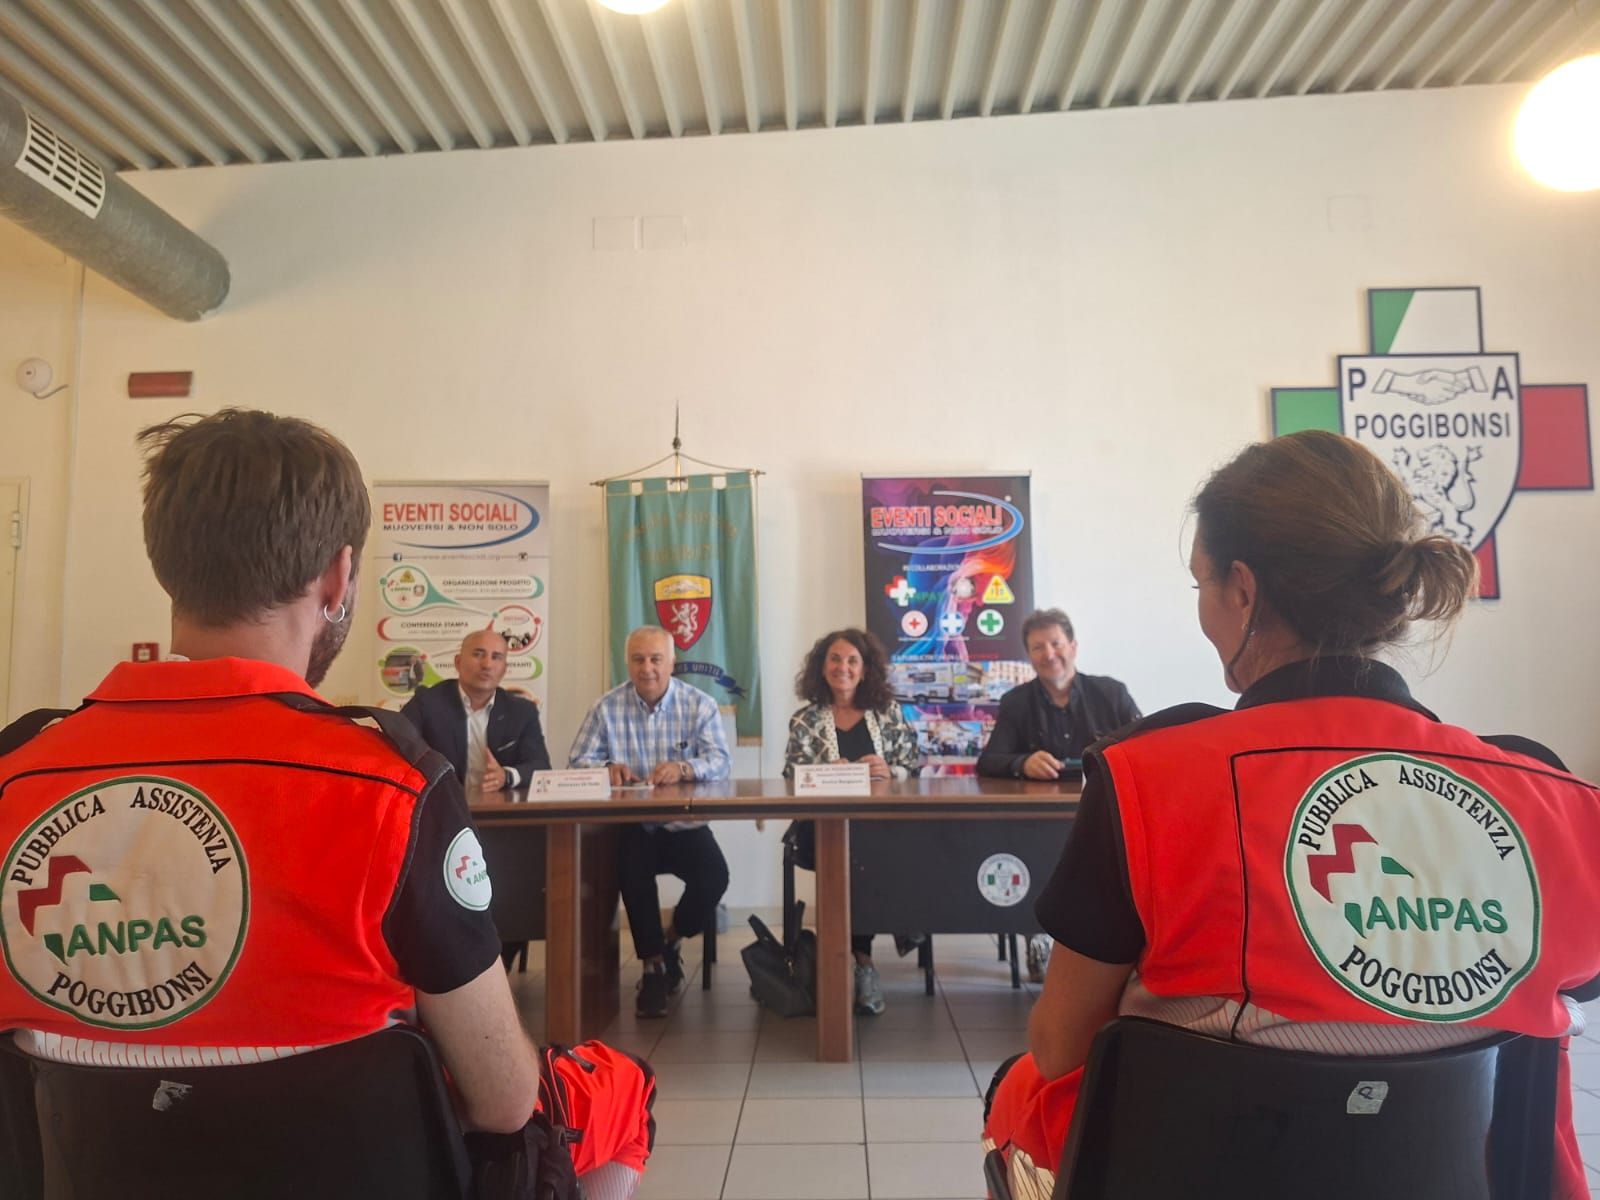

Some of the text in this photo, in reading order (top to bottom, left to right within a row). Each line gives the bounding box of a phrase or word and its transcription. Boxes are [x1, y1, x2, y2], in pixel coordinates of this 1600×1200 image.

[1348, 368, 1367, 401] P
[1492, 366, 1514, 400] A
[1355, 412, 1511, 438] POGGIBONSI
[383, 503, 518, 522] EVENTI SOCIALI
[871, 505, 1003, 528] EVENTI SOCIALI
[401, 621, 443, 629] CONFERENZA
[1298, 764, 1515, 860] PUBBLICA ASSISTENZA
[10, 786, 232, 886] PUBBLICA ASSISTENZA
[1366, 896, 1508, 934] ANPAS
[66, 915, 207, 958] ANPAS
[47, 961, 213, 1018] POGGIBONSI
[1339, 944, 1512, 1005] POGGIBONSI
